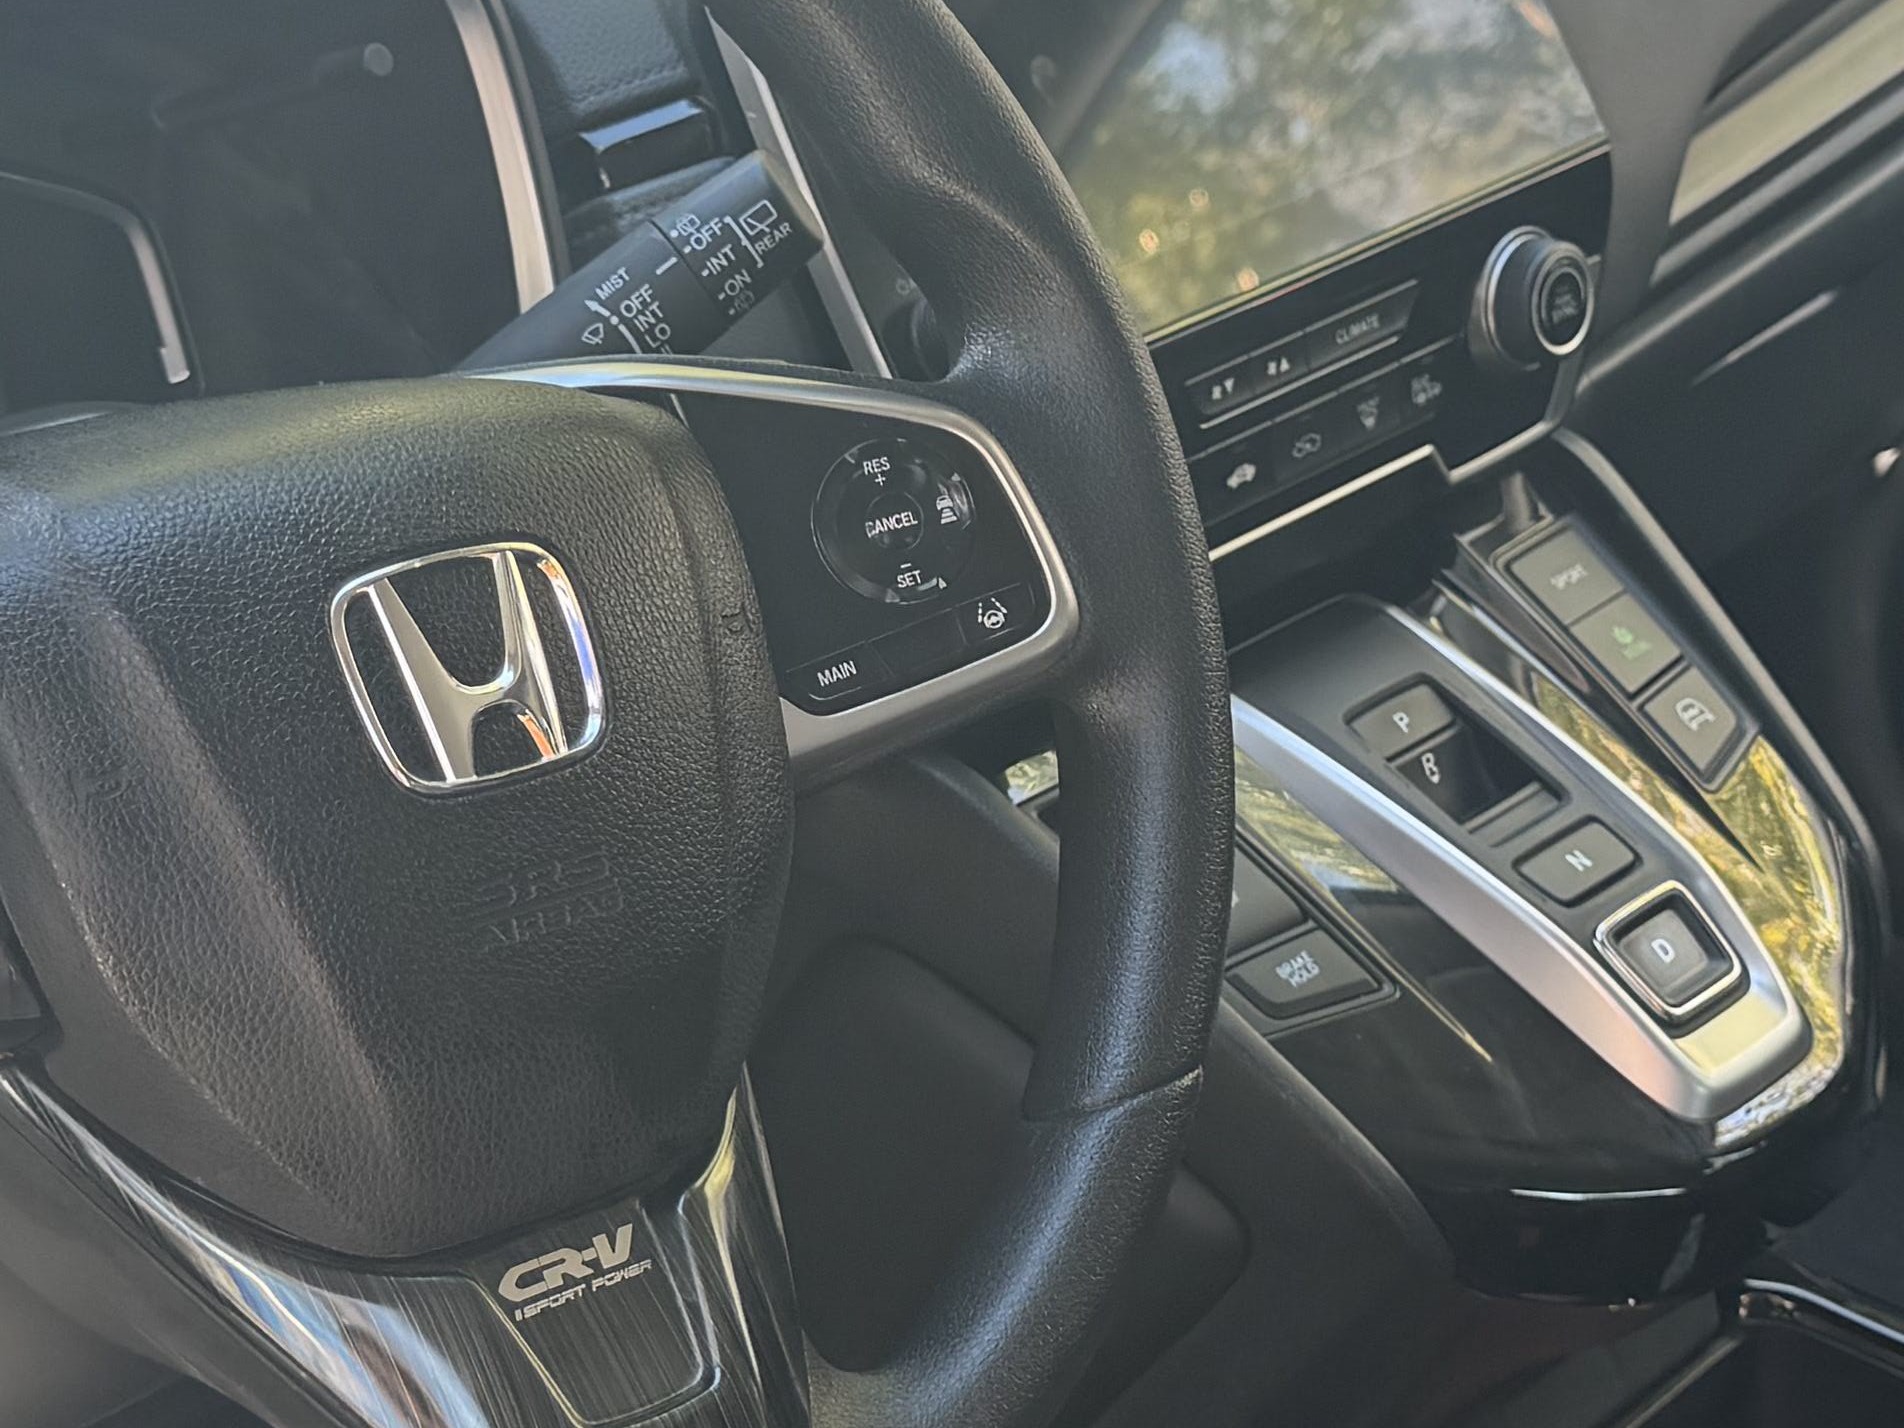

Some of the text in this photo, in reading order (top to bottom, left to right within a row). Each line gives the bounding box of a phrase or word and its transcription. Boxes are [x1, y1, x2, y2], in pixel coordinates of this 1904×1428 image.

[691, 217, 726, 251] OFF
[754, 221, 793, 255] REAR
[706, 244, 738, 276] INT
[596, 267, 630, 300] MIST
[724, 270, 752, 297] ON
[620, 283, 656, 319] OFF
[633, 303, 666, 332] INT
[644, 323, 671, 349] LO
[863, 456, 891, 476] RES
[865, 511, 918, 538] CANCEL
[896, 570, 922, 589] SET
[816, 660, 858, 687] MAIN
[1564, 849, 1593, 872] N
[1650, 938, 1676, 964] D
[498, 1223, 633, 1301] CR-V
[523, 1259, 652, 1319] SPORT POWER
